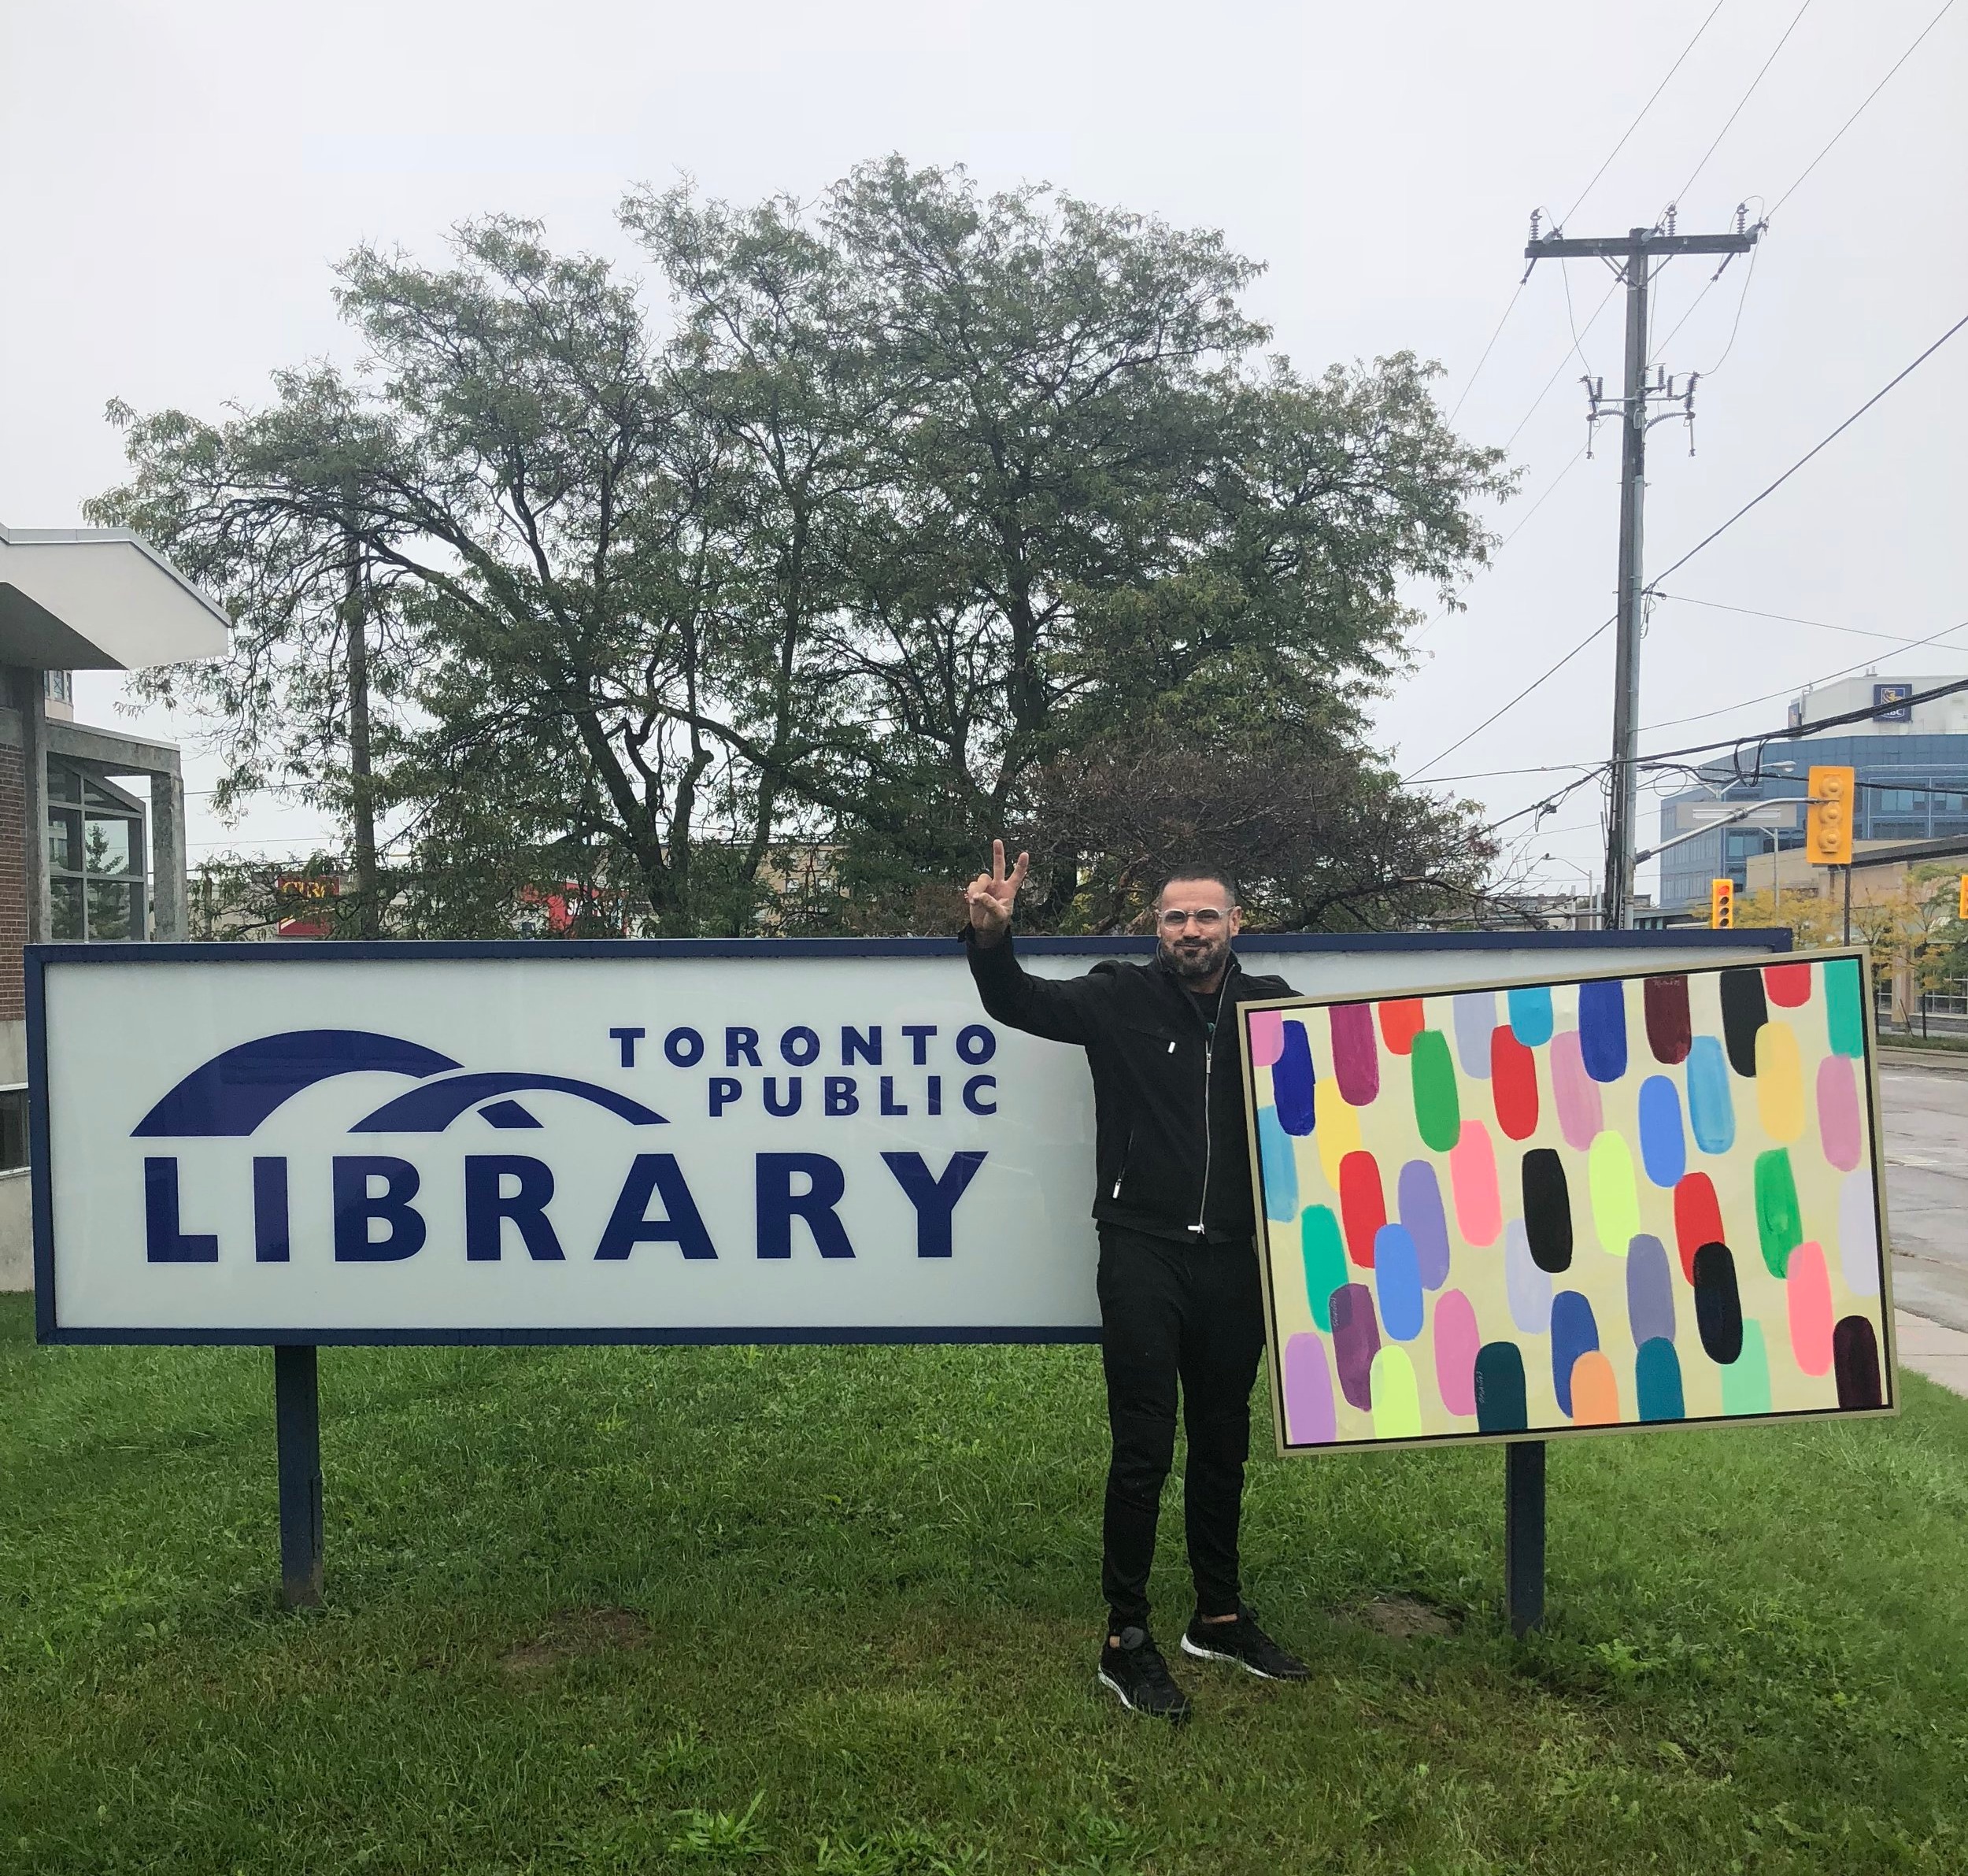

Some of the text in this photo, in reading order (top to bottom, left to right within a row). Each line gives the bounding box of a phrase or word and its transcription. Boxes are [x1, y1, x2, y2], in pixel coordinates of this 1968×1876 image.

[610, 1025, 997, 1068] TORONTO
[709, 1075, 997, 1116] PUBLIC
[144, 1152, 988, 1262] LIBRARY
